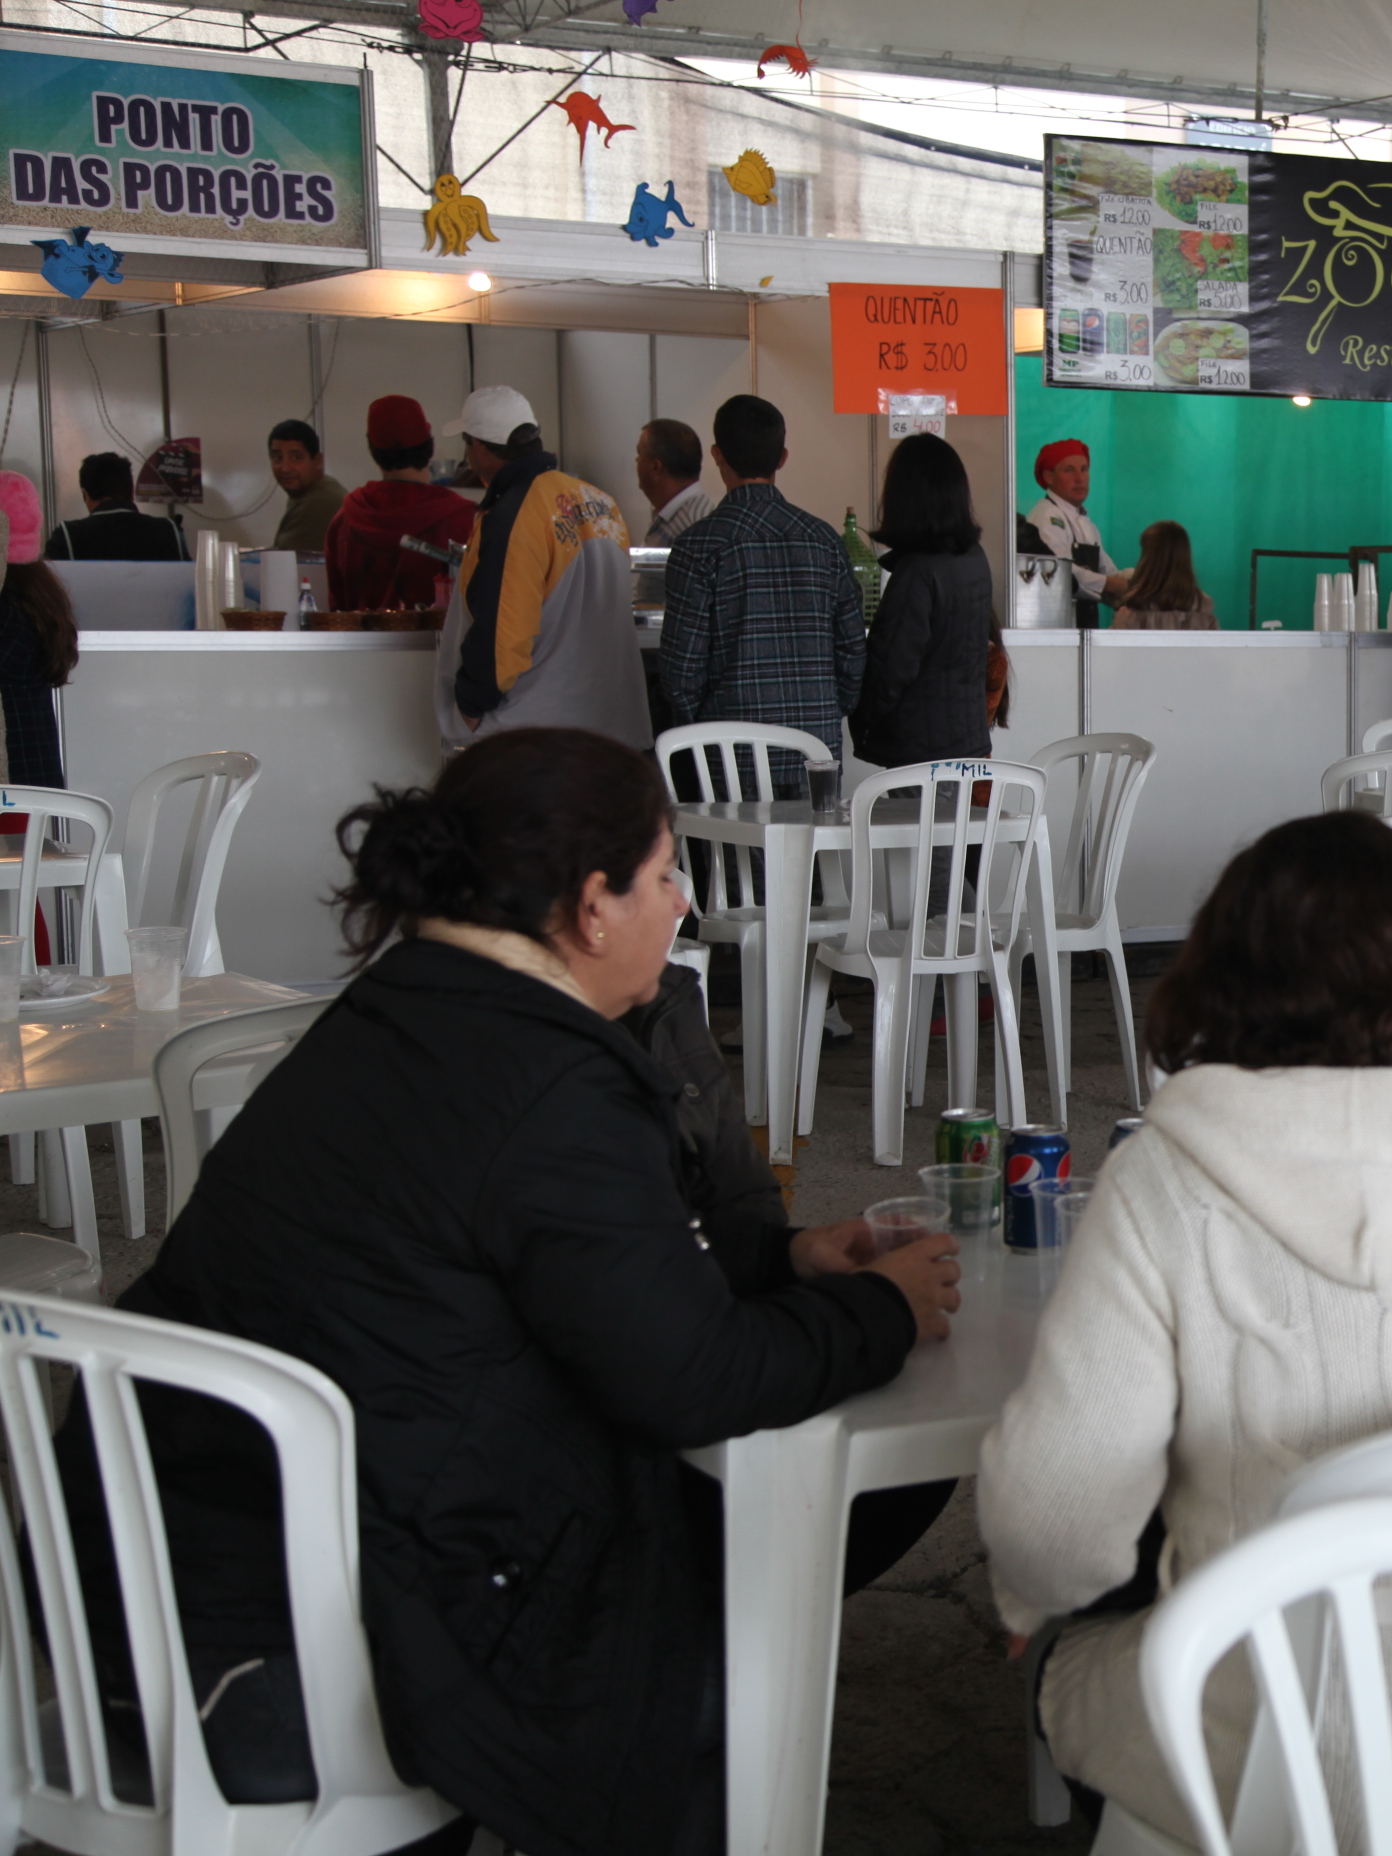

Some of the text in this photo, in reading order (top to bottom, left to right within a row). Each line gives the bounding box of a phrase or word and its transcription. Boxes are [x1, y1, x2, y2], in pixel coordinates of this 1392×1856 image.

[94, 93, 251, 157] PONTO
[12, 151, 336, 227] DAS PORÇÕES
[1104, 213, 1117, 223] R$
[1199, 220, 1211, 230] R$
[865, 291, 959, 326] QUENTÃO
[1199, 297, 1212, 308] R$
[878, 341, 909, 371] R$
[1200, 375, 1213, 385] R$
[961, 762, 993, 778] MIL
